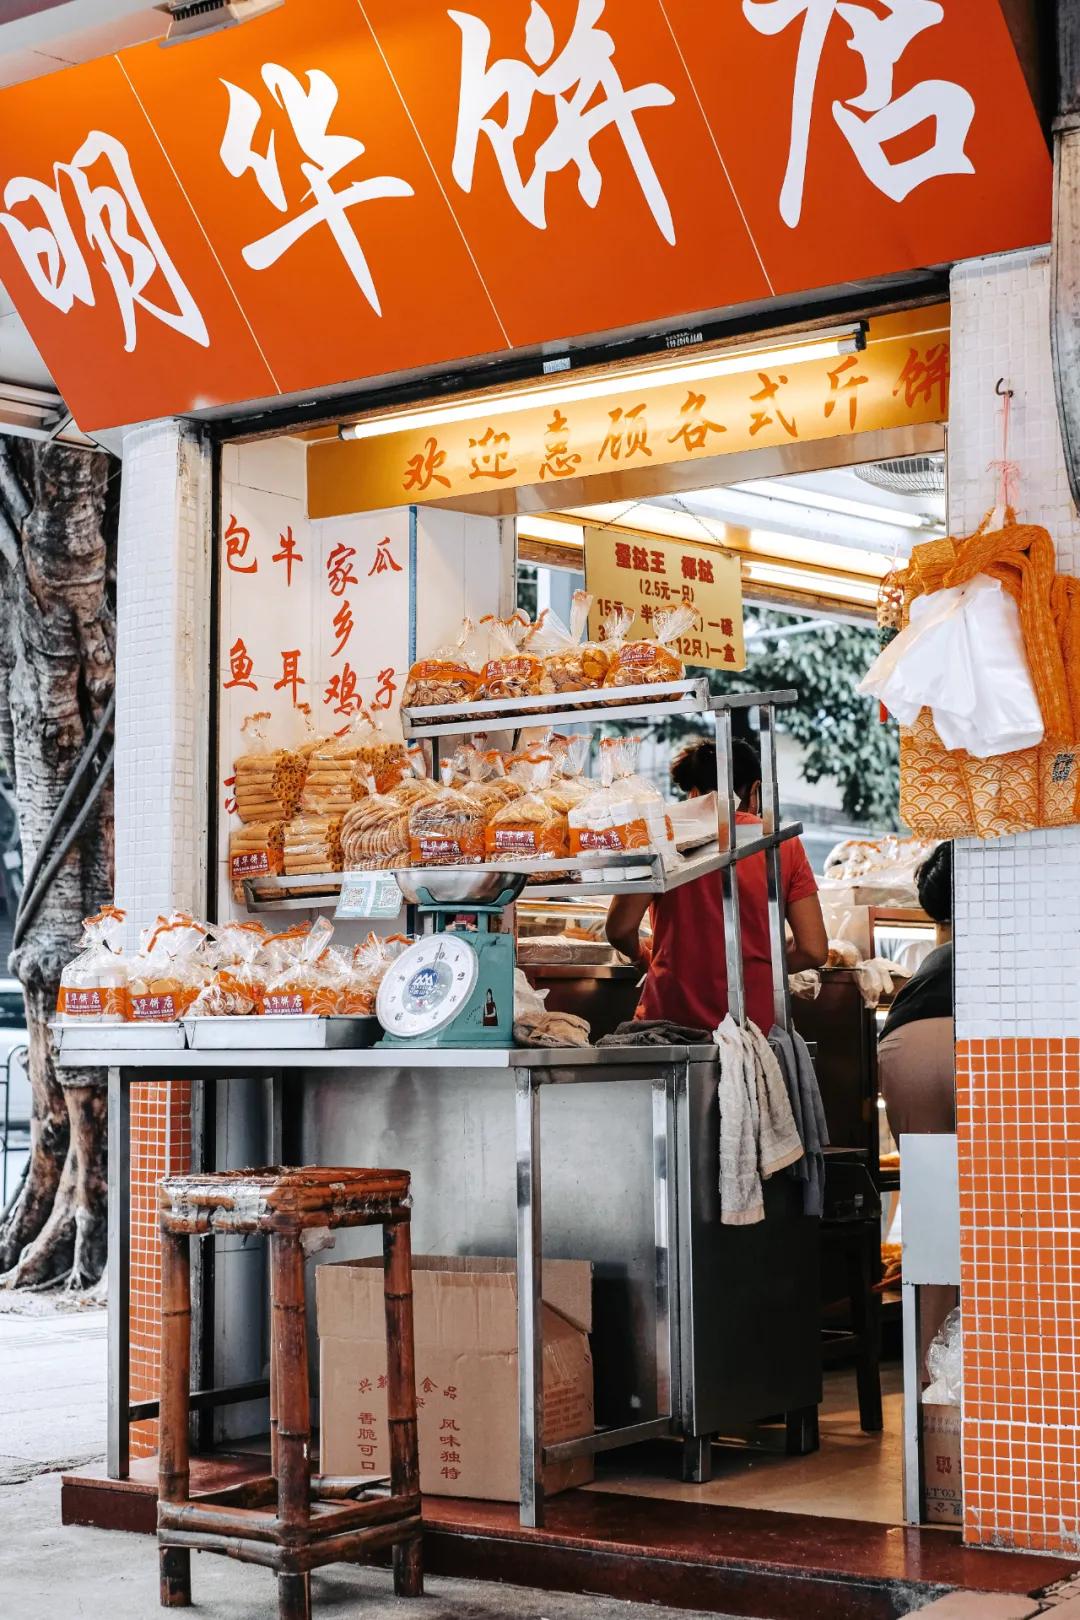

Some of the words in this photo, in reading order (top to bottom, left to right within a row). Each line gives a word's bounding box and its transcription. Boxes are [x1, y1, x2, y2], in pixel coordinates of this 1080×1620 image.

[0, 0, 976, 352] 明华饼店
[272, 526, 306, 709] 牛耳
[323, 542, 363, 738] 家乡鸡
[368, 536, 403, 709] 瓜子
[358, 1412, 378, 1471] 香脆可口
[439, 1418, 461, 1481] 风味独特
